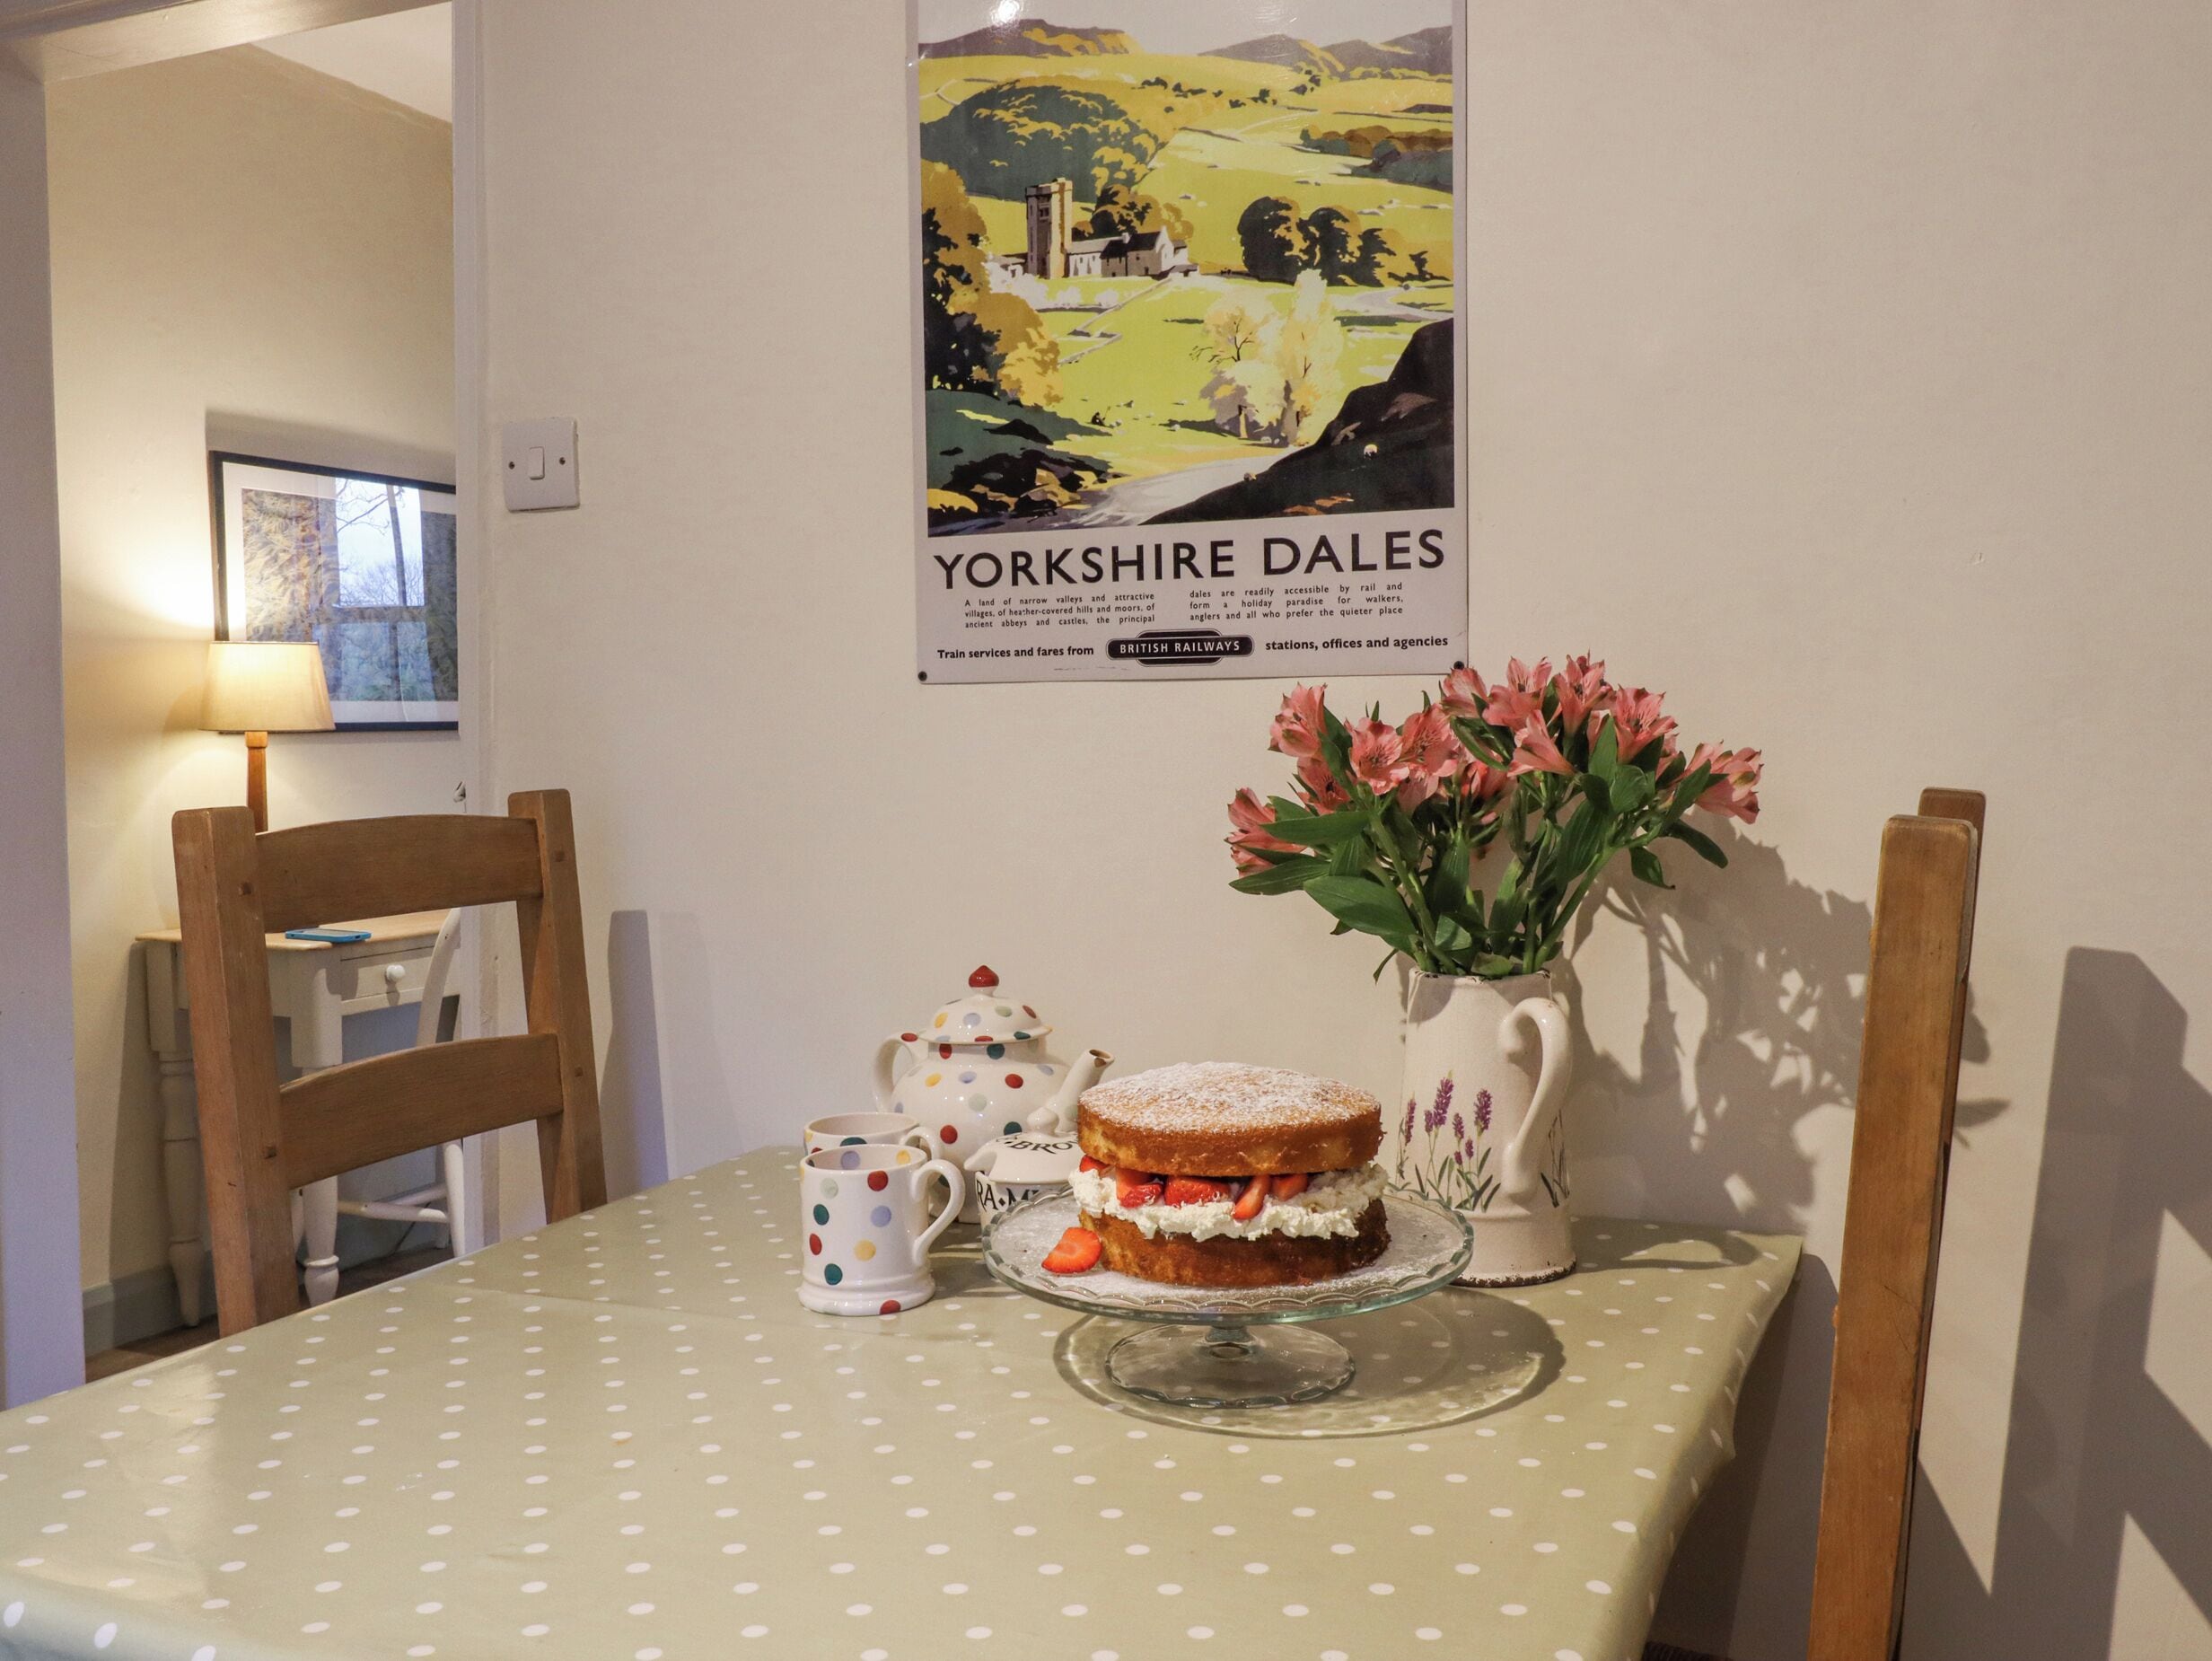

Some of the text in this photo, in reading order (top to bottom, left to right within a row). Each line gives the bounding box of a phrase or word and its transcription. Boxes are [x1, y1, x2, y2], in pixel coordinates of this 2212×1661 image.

[934, 529, 1444, 589] YORKSHIRE DALES
[1189, 589, 1211, 599] dales
[1244, 586, 1275, 598] readily
[1284, 584, 1330, 595] accessible
[1339, 584, 1350, 595] by
[1360, 583, 1376, 592] rail
[1386, 581, 1402, 591] and
[964, 599, 971, 607] A
[979, 597, 995, 607] land
[1003, 597, 1012, 606] of
[1056, 594, 1083, 605] valleys
[1091, 593, 1106, 602] and
[1114, 593, 1154, 602] attractive
[1189, 601, 1210, 610] form
[1241, 598, 1273, 610] holiday
[1286, 596, 1324, 609] paradise
[1337, 595, 1351, 604] for
[997, 608, 1006, 617] of
[1008, 605, 1074, 616] heather-covered
[1076, 605, 1093, 614] hills
[1096, 604, 1111, 613] and
[1146, 602, 1155, 611] of
[1189, 605, 1403, 623] anglers and all who prefer the quieter place
[965, 620, 994, 628] ancient
[1001, 619, 1028, 628] abbeys
[1035, 617, 1050, 627] and
[1096, 615, 1110, 624] the
[1119, 613, 1155, 626] principal
[1119, 640, 1240, 654] BRITISH RAILWAYS
[1265, 635, 1449, 651] stations, offices and agencies
[936, 646, 1094, 659] Train services and fares from
